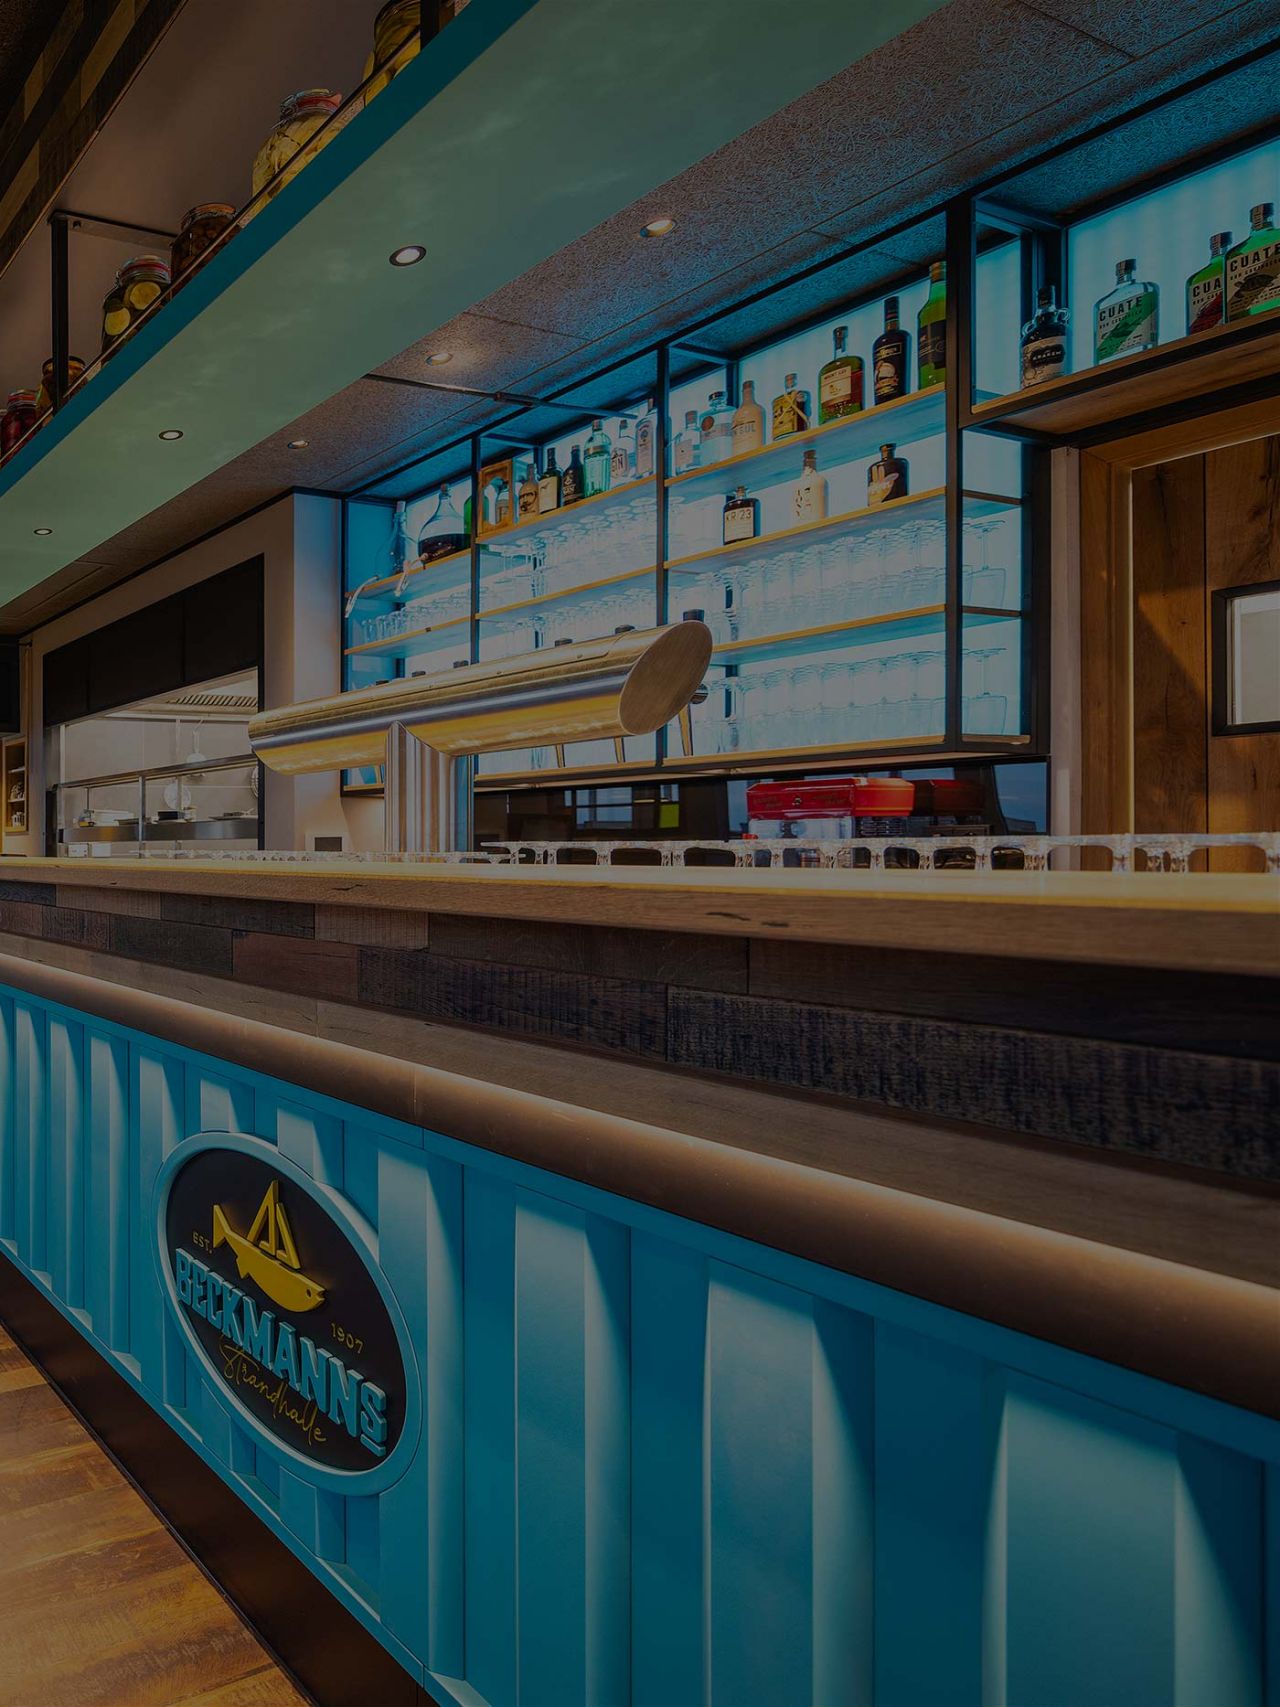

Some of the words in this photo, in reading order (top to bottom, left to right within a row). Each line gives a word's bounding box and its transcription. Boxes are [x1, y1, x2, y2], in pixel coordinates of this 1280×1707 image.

[1230, 242, 1280, 272] CUATE
[1192, 277, 1221, 298] CUA
[1099, 296, 1142, 322] CUATE
[191, 1230, 214, 1254] EST.
[175, 1247, 389, 1446] BECKMANNS
[331, 1322, 365, 1355] 1907
[219, 1334, 327, 1446] Strandhalle
